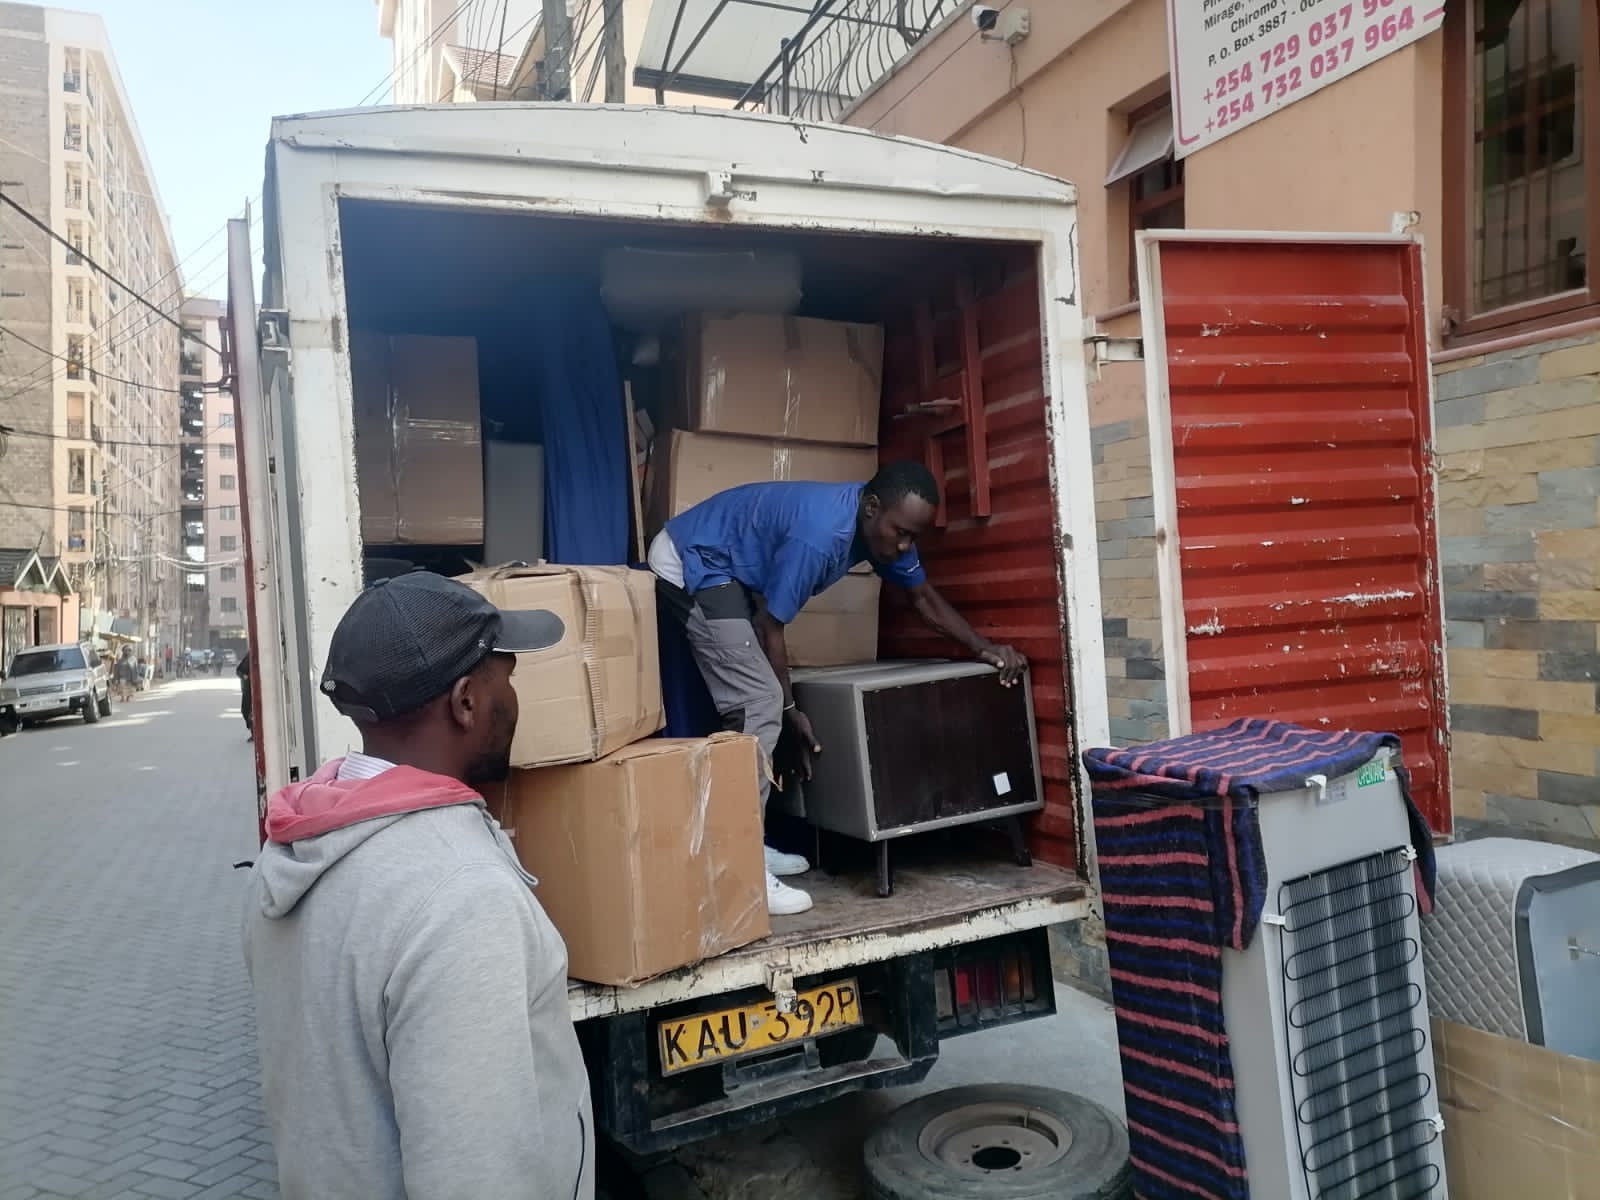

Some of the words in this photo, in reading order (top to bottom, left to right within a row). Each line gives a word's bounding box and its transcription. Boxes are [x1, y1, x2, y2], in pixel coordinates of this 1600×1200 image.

[1204, 1, 1245, 31] Mirage,
[1208, 54, 1217, 67] P.
[1220, 47, 1231, 60] O.
[1234, 33, 1255, 52] Box
[1258, 10, 1287, 37] 3887
[1231, 0, 1278, 33] Chiromo
[1203, 62, 1253, 104] +254
[1260, 34, 1300, 74] 729
[1308, 5, 1353, 47] 037
[1204, 91, 1255, 134] +254
[1261, 66, 1302, 105] 732
[1310, 38, 1355, 79] 037
[1364, 6, 1415, 51] 964
[664, 1011, 747, 1065] KAU
[764, 986, 854, 1042] 392P
